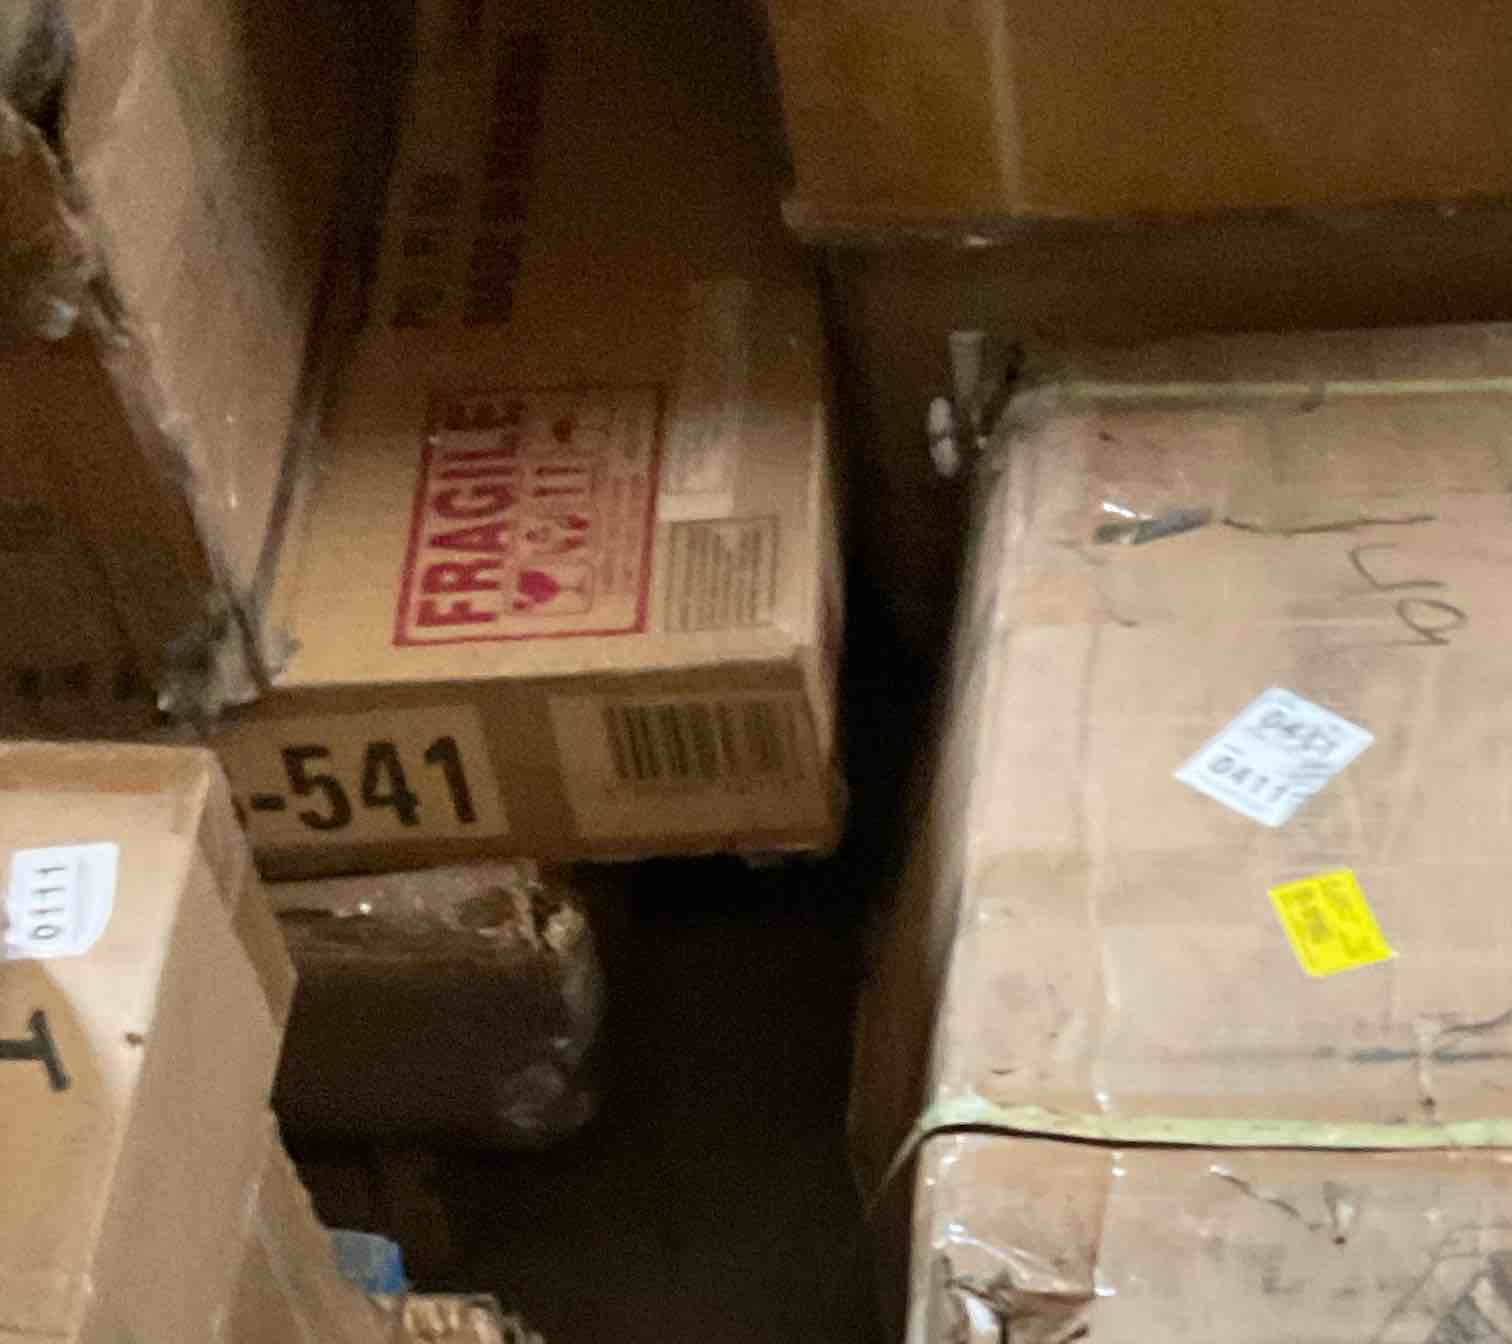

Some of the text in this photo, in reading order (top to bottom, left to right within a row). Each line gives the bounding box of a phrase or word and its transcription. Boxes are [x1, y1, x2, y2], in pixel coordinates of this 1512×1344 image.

[414, 398, 526, 629] FRAGILE
[249, 735, 479, 832] -541
[28, 864, 68, 941] 0111
